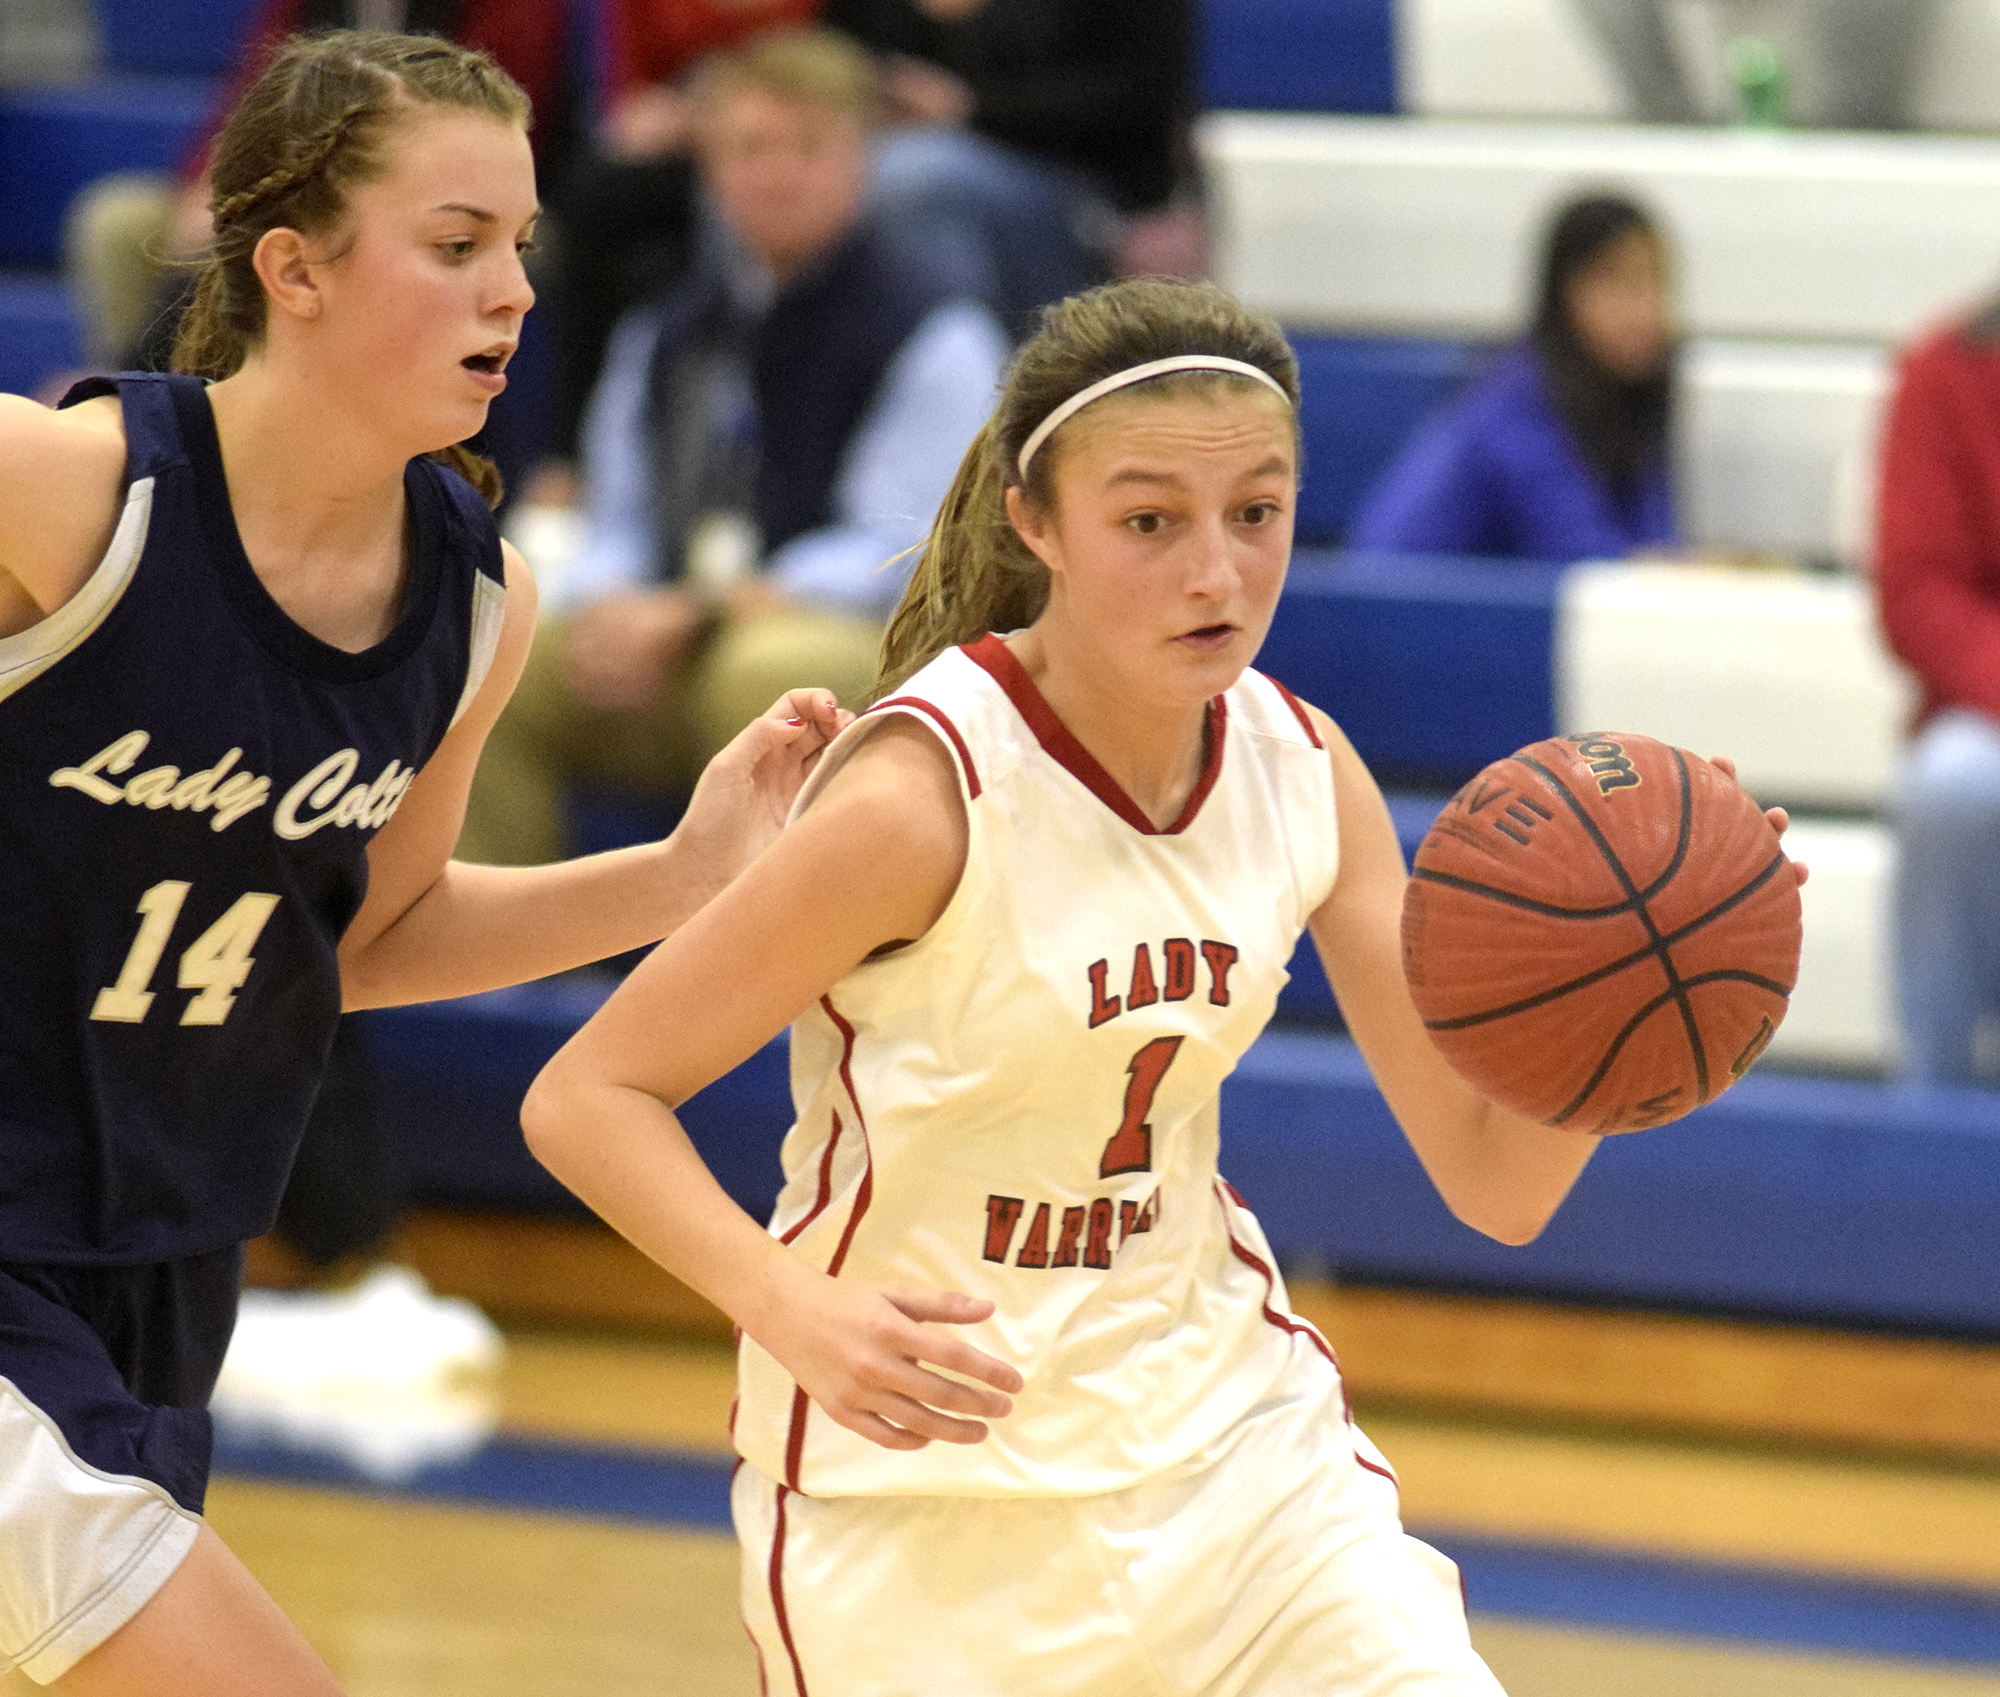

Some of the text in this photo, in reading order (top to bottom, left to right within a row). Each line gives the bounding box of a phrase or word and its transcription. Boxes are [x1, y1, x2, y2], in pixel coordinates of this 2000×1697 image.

[49, 730, 271, 832] Lady
[89, 879, 283, 1026] 14
[1088, 937, 1239, 1029] LADY
[1098, 1034, 1186, 1180] 1
